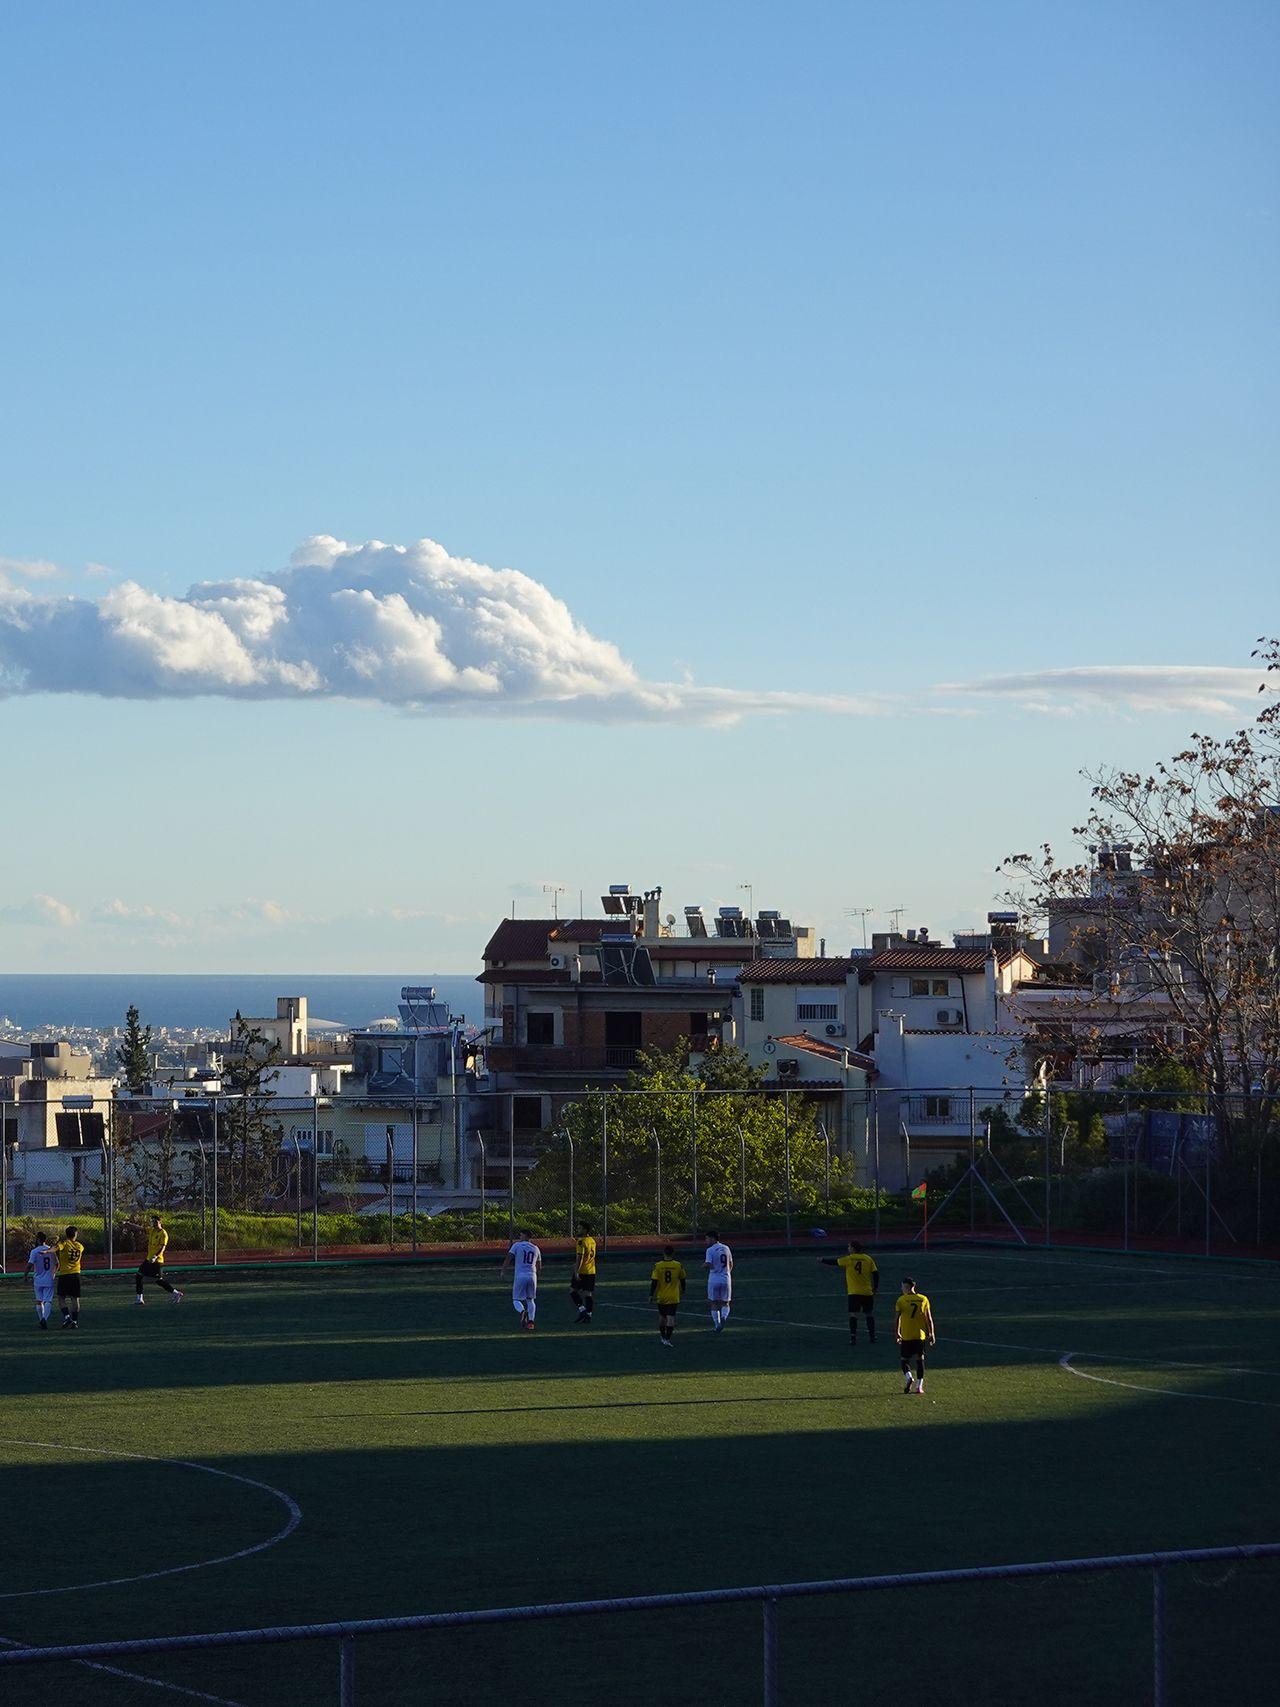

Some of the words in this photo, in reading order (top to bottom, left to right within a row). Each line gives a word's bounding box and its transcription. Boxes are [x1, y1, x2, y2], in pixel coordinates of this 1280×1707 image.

[43, 1256, 51, 1271] 8
[523, 1250, 534, 1264] 10
[720, 1253, 727, 1268] 9
[854, 1261, 862, 1274] 4
[664, 1270, 672, 1283] 8
[910, 1302, 918, 1318] 7
